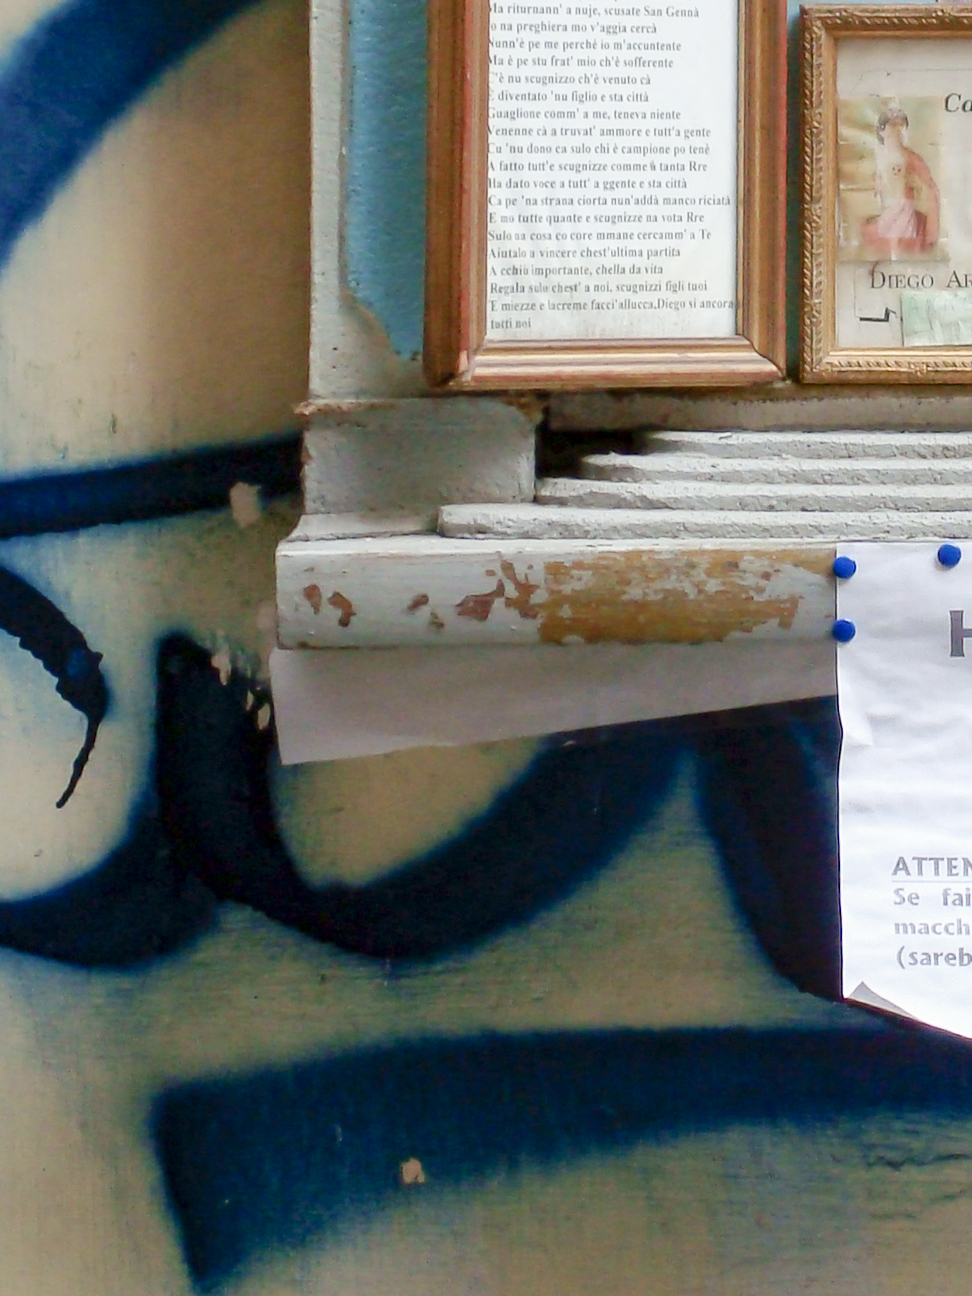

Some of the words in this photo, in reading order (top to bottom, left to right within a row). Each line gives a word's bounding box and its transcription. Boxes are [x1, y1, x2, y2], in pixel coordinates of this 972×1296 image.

[870, 271, 934, 289] DIEGO
[893, 887, 921, 907] Se
[941, 886, 972, 908] fai
